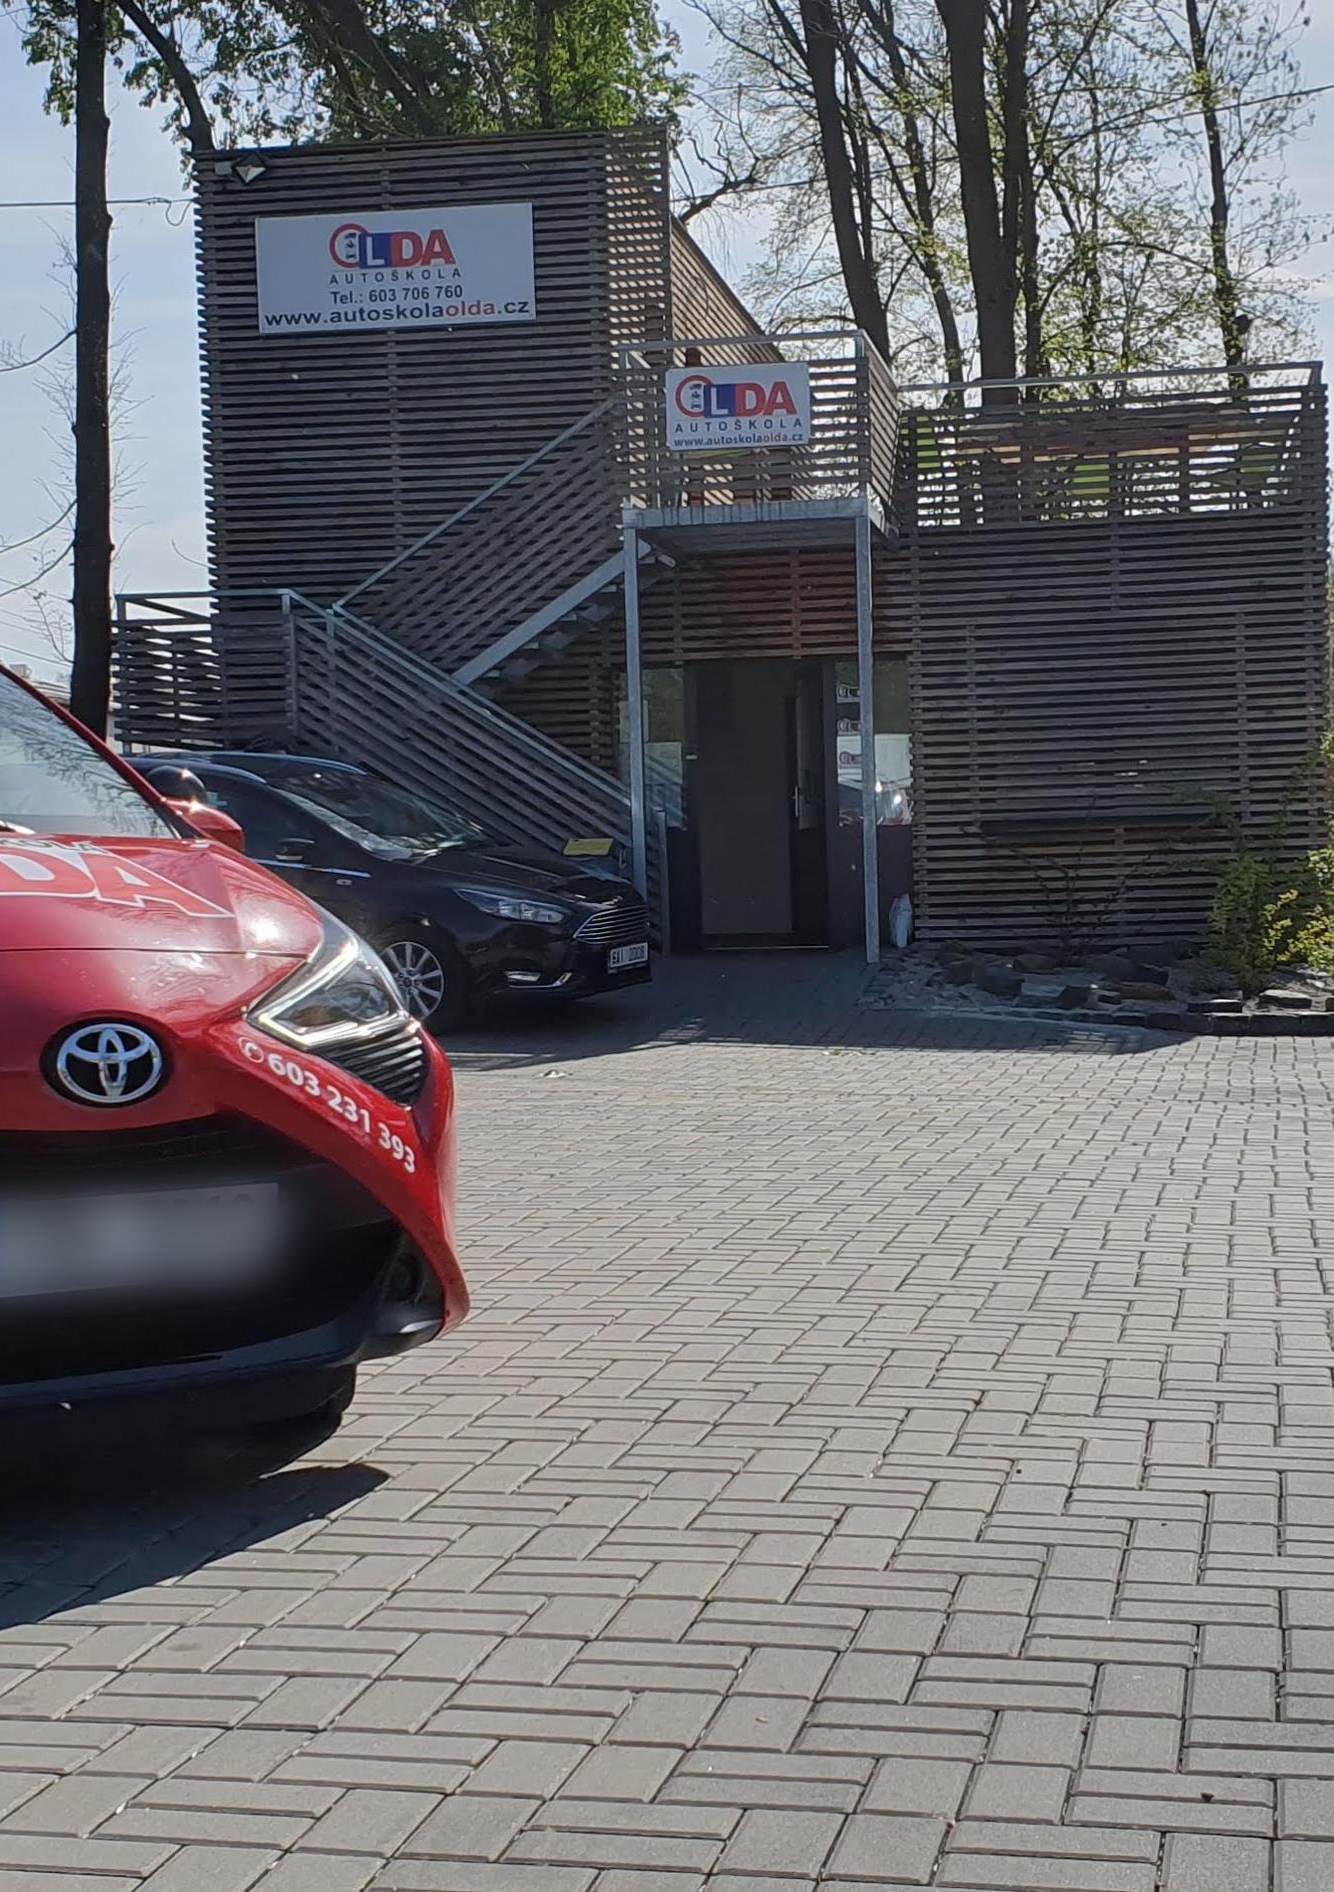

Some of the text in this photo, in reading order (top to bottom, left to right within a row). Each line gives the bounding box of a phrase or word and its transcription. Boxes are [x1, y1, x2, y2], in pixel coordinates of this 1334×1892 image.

[329, 268, 461, 285] AUTOŠKOLA
[331, 284, 464, 305] Tel.: 603 706 760
[264, 300, 530, 326] www.autoskolaolda.cz
[675, 417, 802, 433] AUTOŠKOLA
[674, 432, 804, 447] www.autoskolaolda.cz
[268, 1053, 416, 1173] 603 231 393
